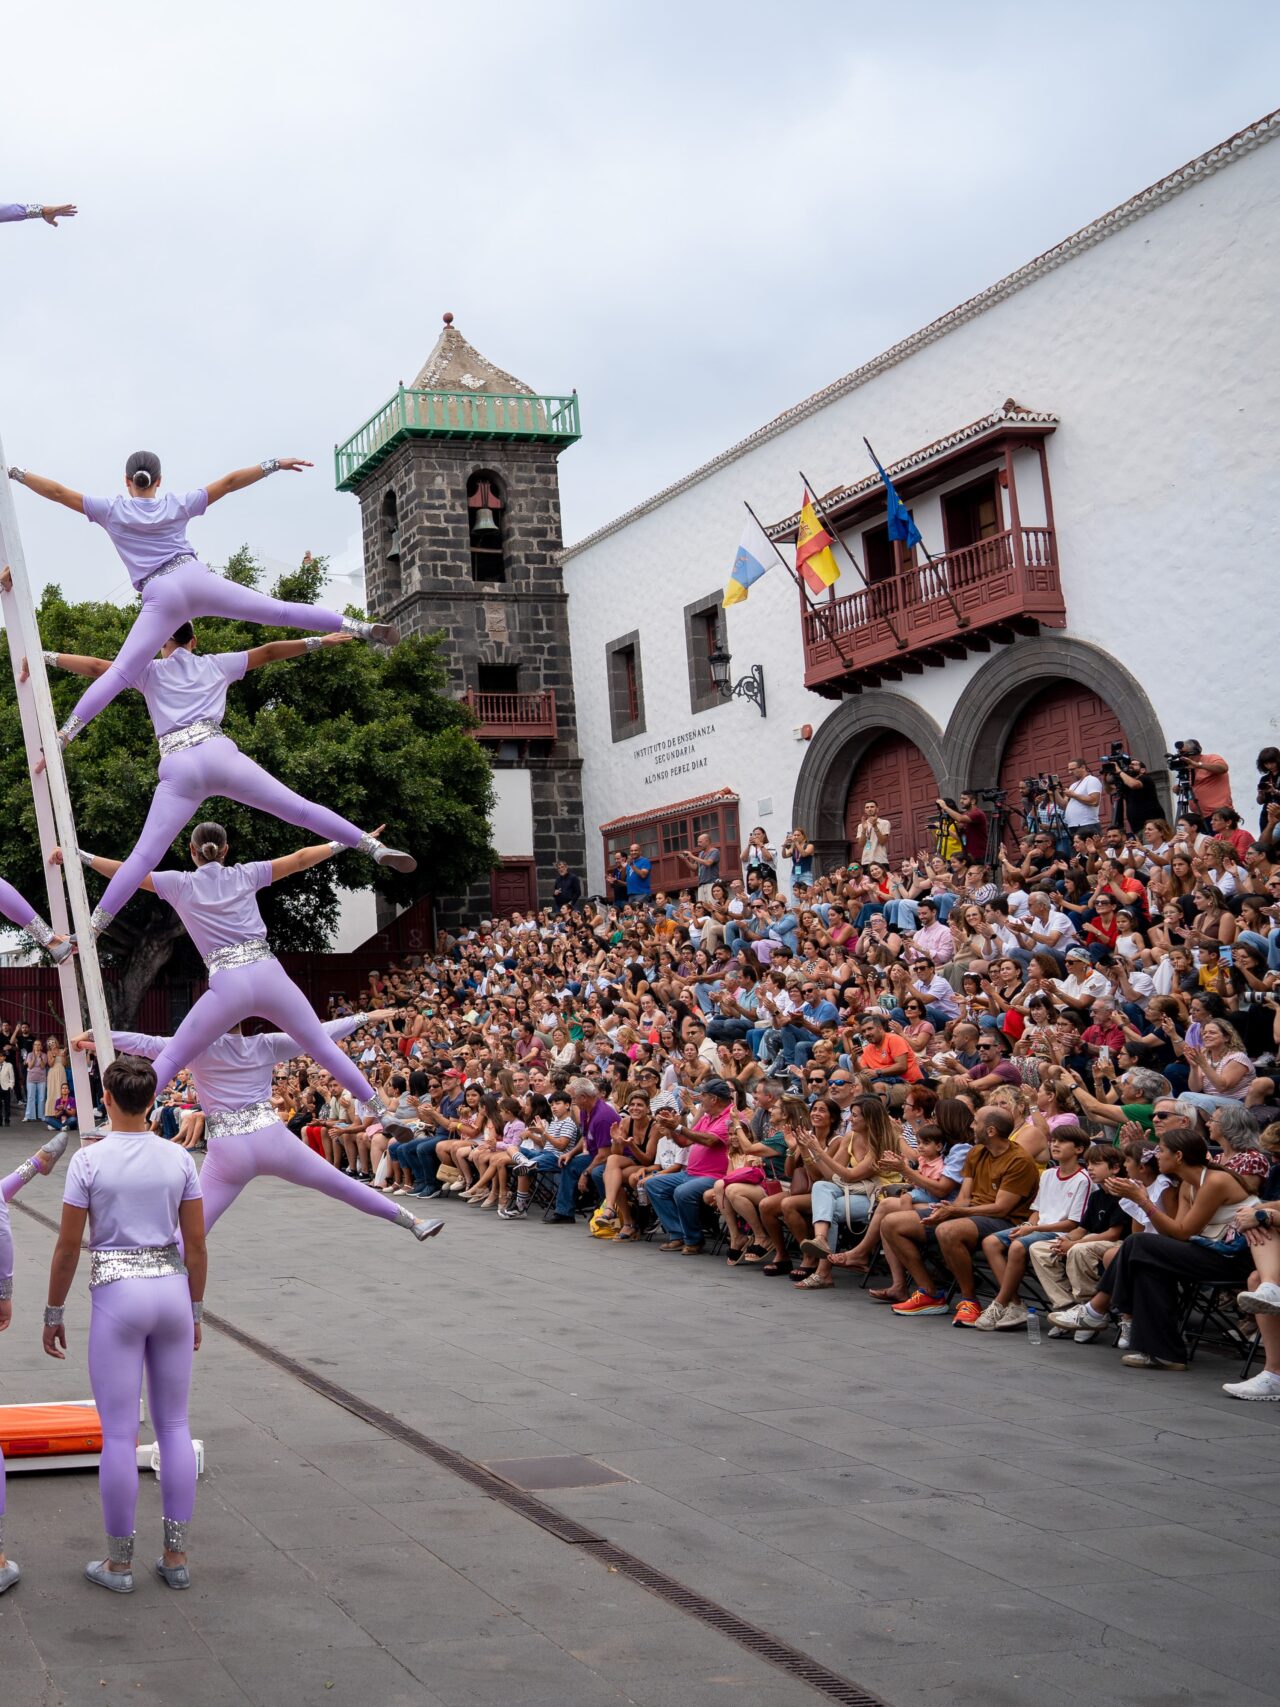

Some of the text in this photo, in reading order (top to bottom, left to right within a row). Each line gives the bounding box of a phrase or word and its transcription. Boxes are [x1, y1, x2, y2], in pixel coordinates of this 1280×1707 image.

[633, 741, 666, 759] INSTITUTO
[667, 737, 677, 748] DE
[654, 744, 696, 765] SECUNDARIA
[644, 770, 669, 785] ALONSO
